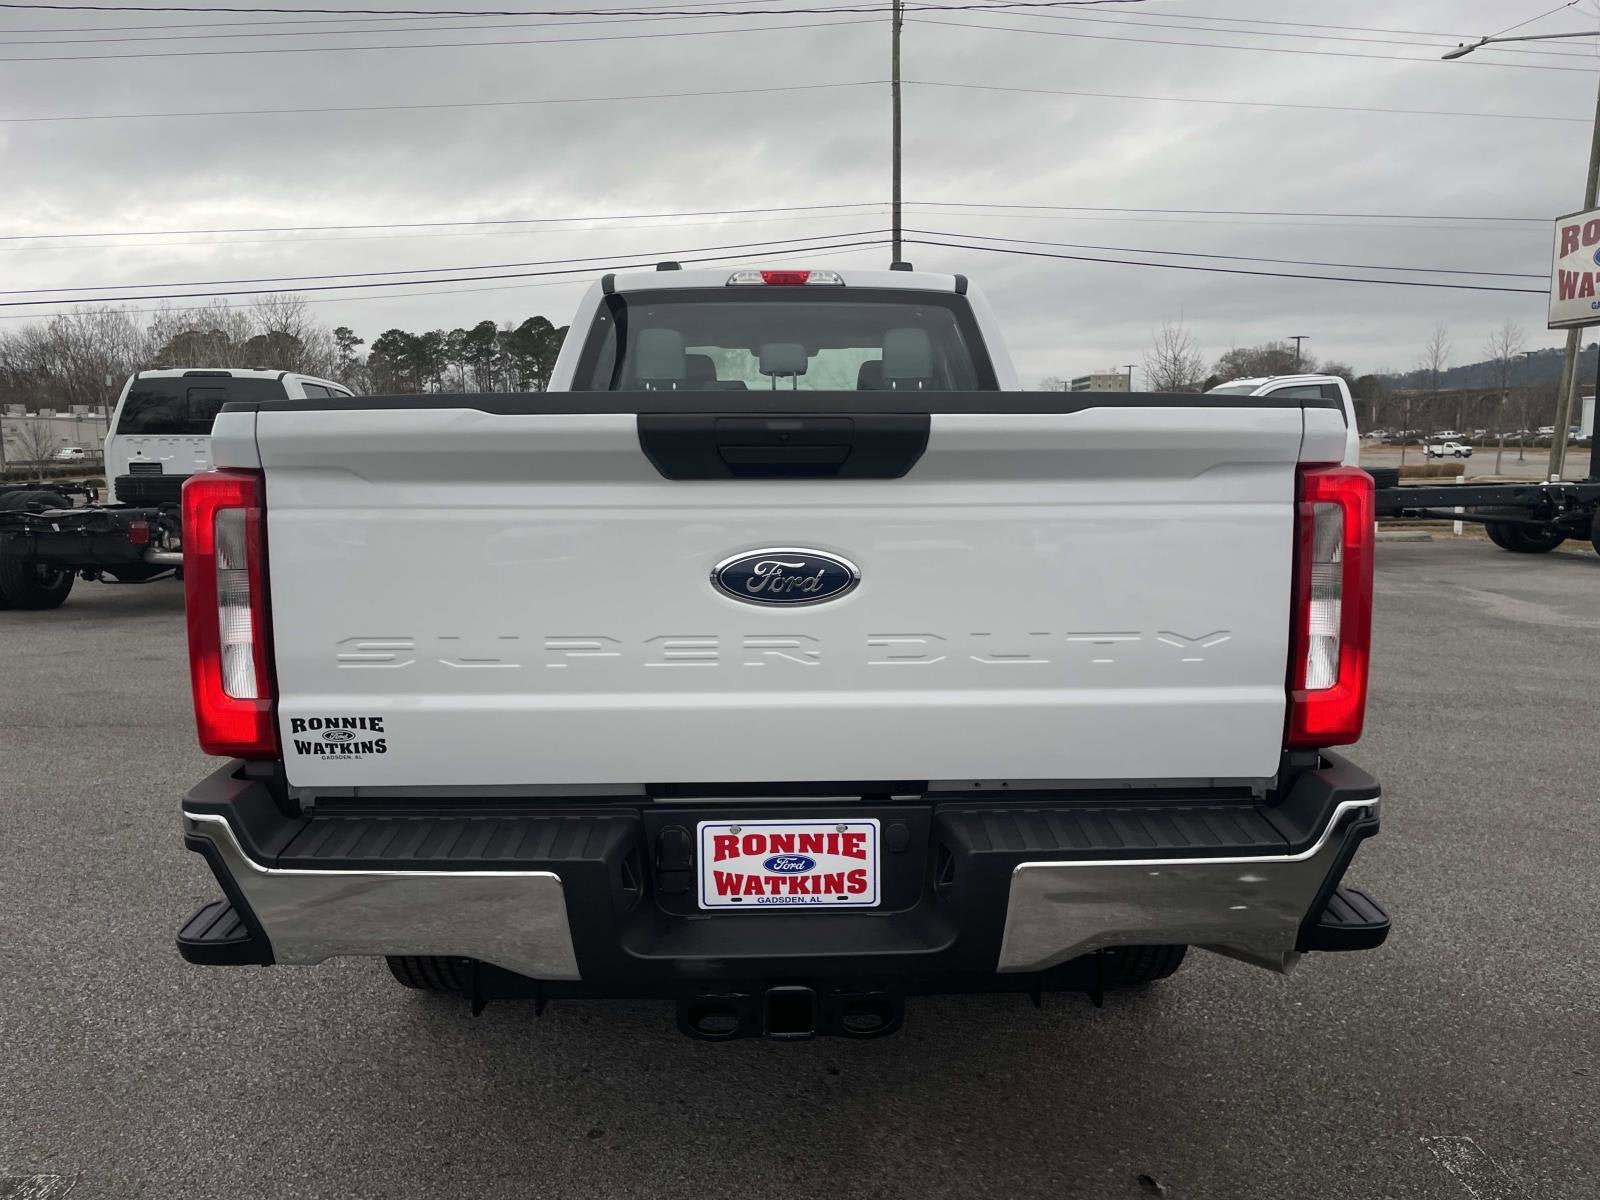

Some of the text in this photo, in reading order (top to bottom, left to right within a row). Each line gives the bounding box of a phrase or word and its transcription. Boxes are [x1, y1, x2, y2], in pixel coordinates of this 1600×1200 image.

[746, 561, 823, 593] Ford
[336, 631, 1230, 668] SUPER DUTY
[290, 717, 384, 733] RONNIE
[293, 738, 387, 754] WATKINS
[713, 833, 867, 862] RONNIE
[773, 857, 806, 870] Ford
[713, 868, 868, 896] WATKINS
[757, 896, 807, 904] GADSDEN,
